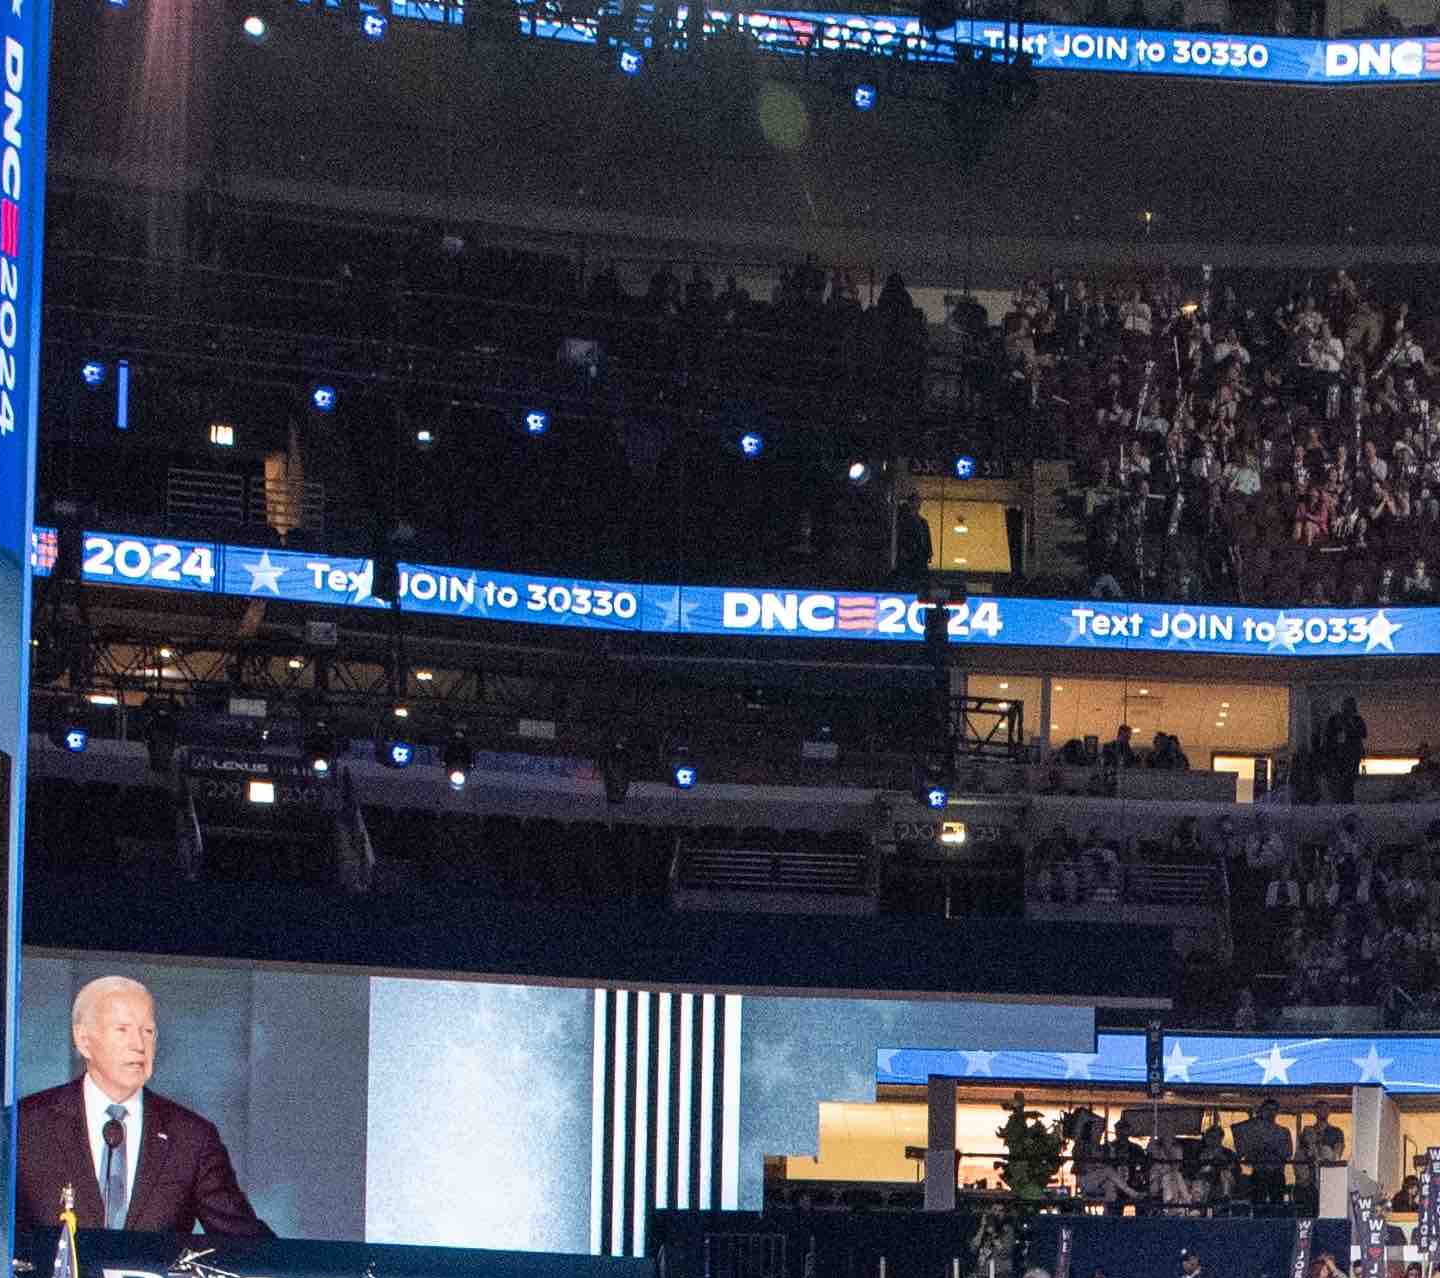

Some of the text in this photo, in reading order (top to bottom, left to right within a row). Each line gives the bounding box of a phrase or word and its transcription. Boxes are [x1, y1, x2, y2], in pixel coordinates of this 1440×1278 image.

[1054, 34, 1127, 61] JOIN
[1136, 37, 1165, 63] to
[1173, 41, 1268, 68] 30330
[1326, 42, 1423, 75] DNC
[0, 35, 24, 200] DNC
[84, 540, 216, 584] 2024
[484, 581, 518, 609] to
[527, 584, 638, 617] 30330
[723, 593, 837, 630] DNC
[1072, 609, 1392, 645] Text JOIN to 3033
